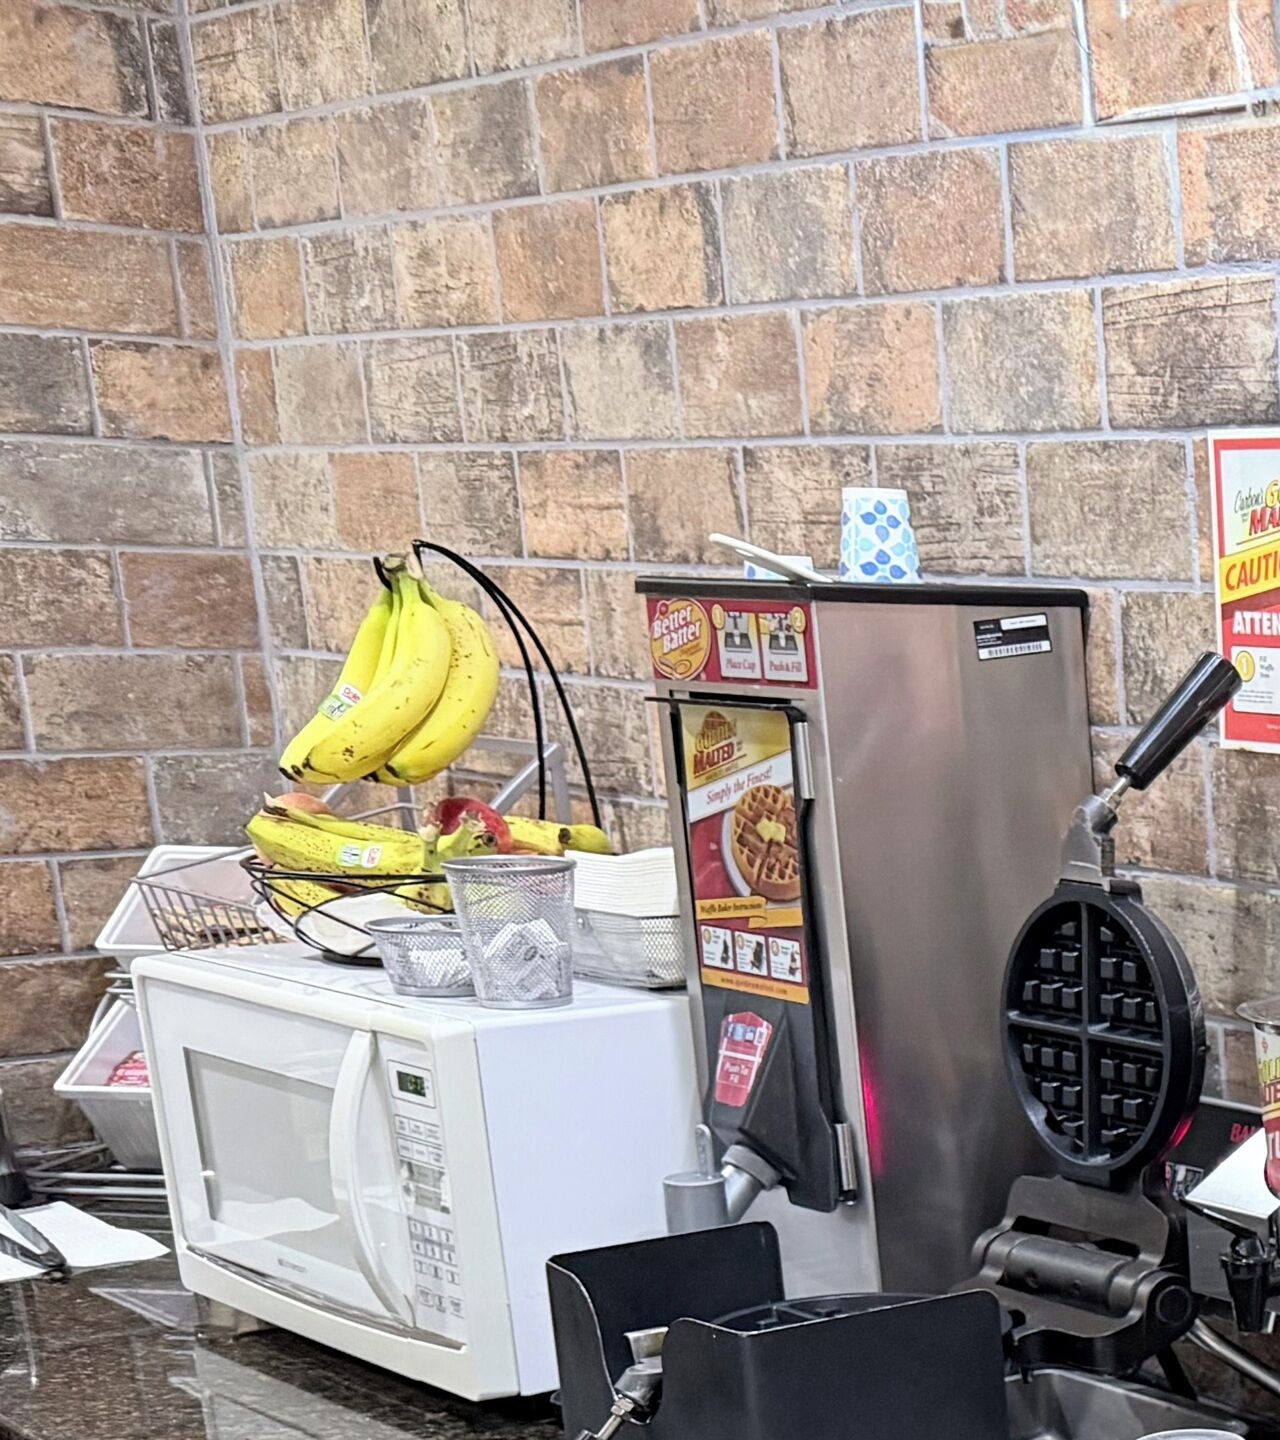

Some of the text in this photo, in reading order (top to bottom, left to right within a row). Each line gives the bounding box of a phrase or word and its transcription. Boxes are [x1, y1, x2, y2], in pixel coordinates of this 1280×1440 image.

[652, 605, 693, 640] Better
[662, 620, 702, 653] Batter
[693, 742, 735, 775] MALTED
[707, 783, 732, 805] Simply
[733, 778, 745, 792] the
